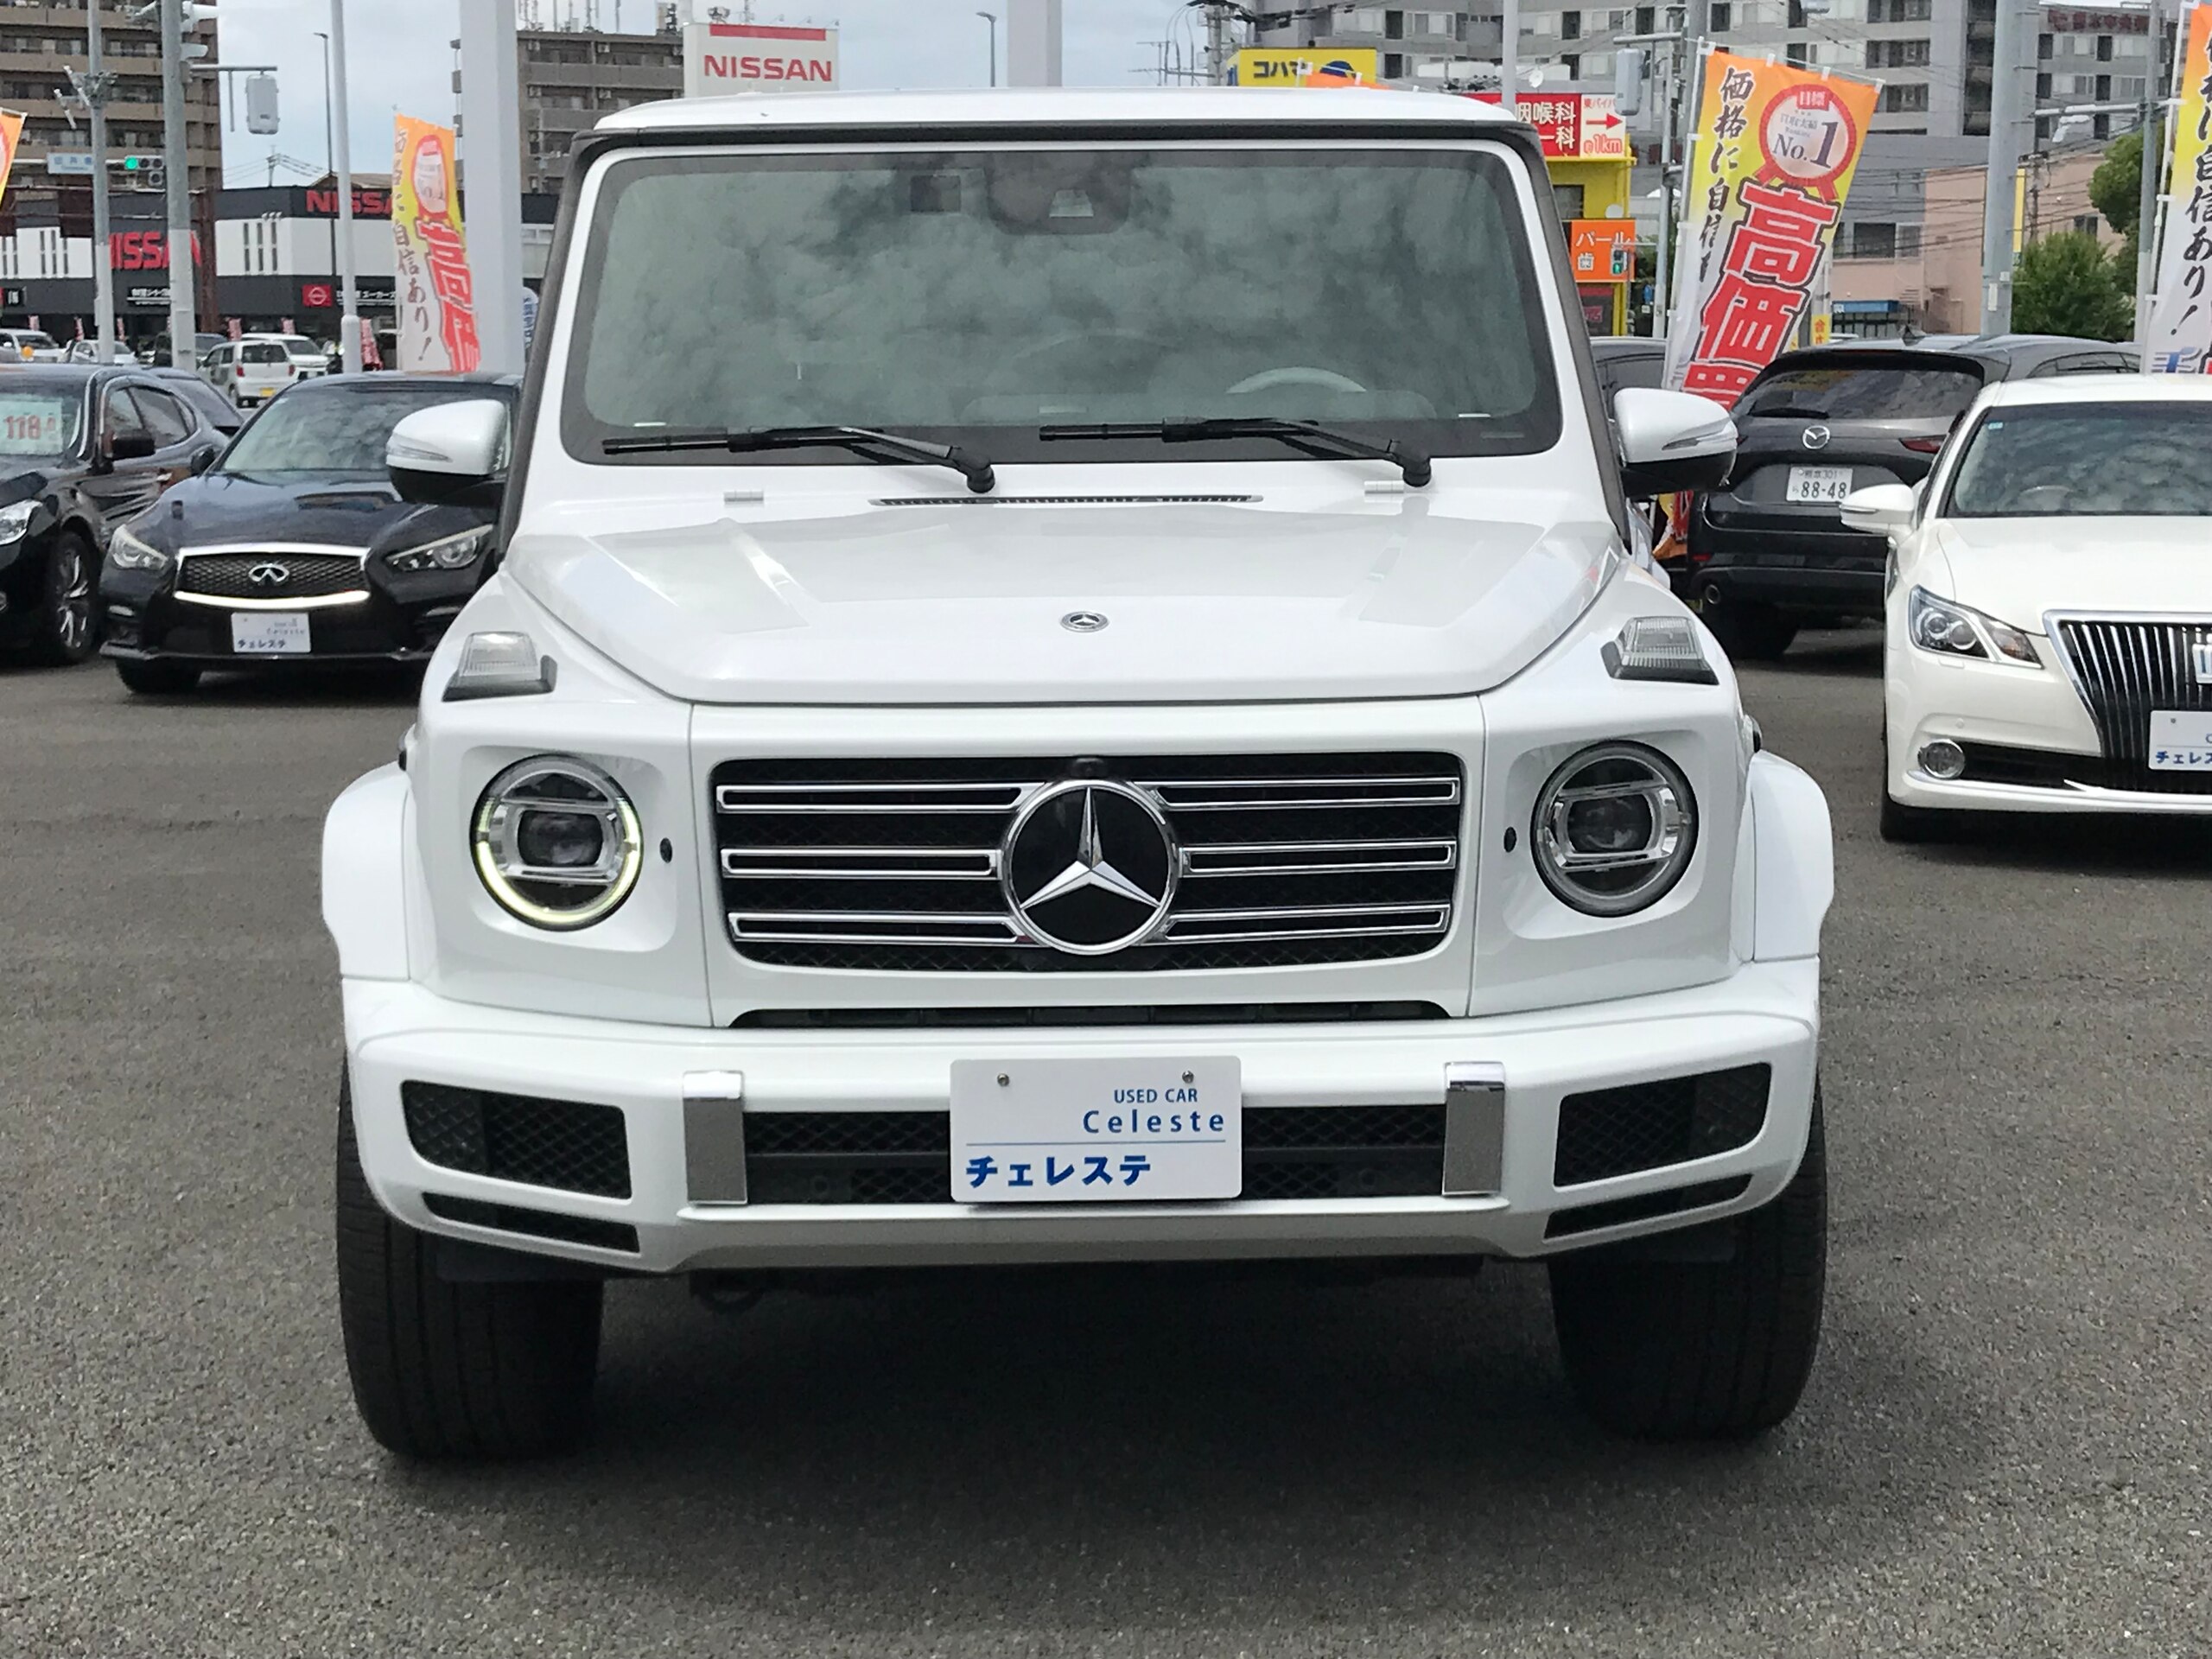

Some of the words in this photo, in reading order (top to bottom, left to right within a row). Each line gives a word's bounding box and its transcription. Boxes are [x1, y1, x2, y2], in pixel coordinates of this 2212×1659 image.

[703, 54, 832, 82] NISSAN
[1575, 231, 1631, 247] パール
[1801, 480, 1847, 499] 88-48
[1113, 1089, 1159, 1104] USED
[1164, 1087, 1198, 1103] CAR
[1083, 1108, 1224, 1134] Celeste
[965, 1154, 1151, 1189] チェレステ
